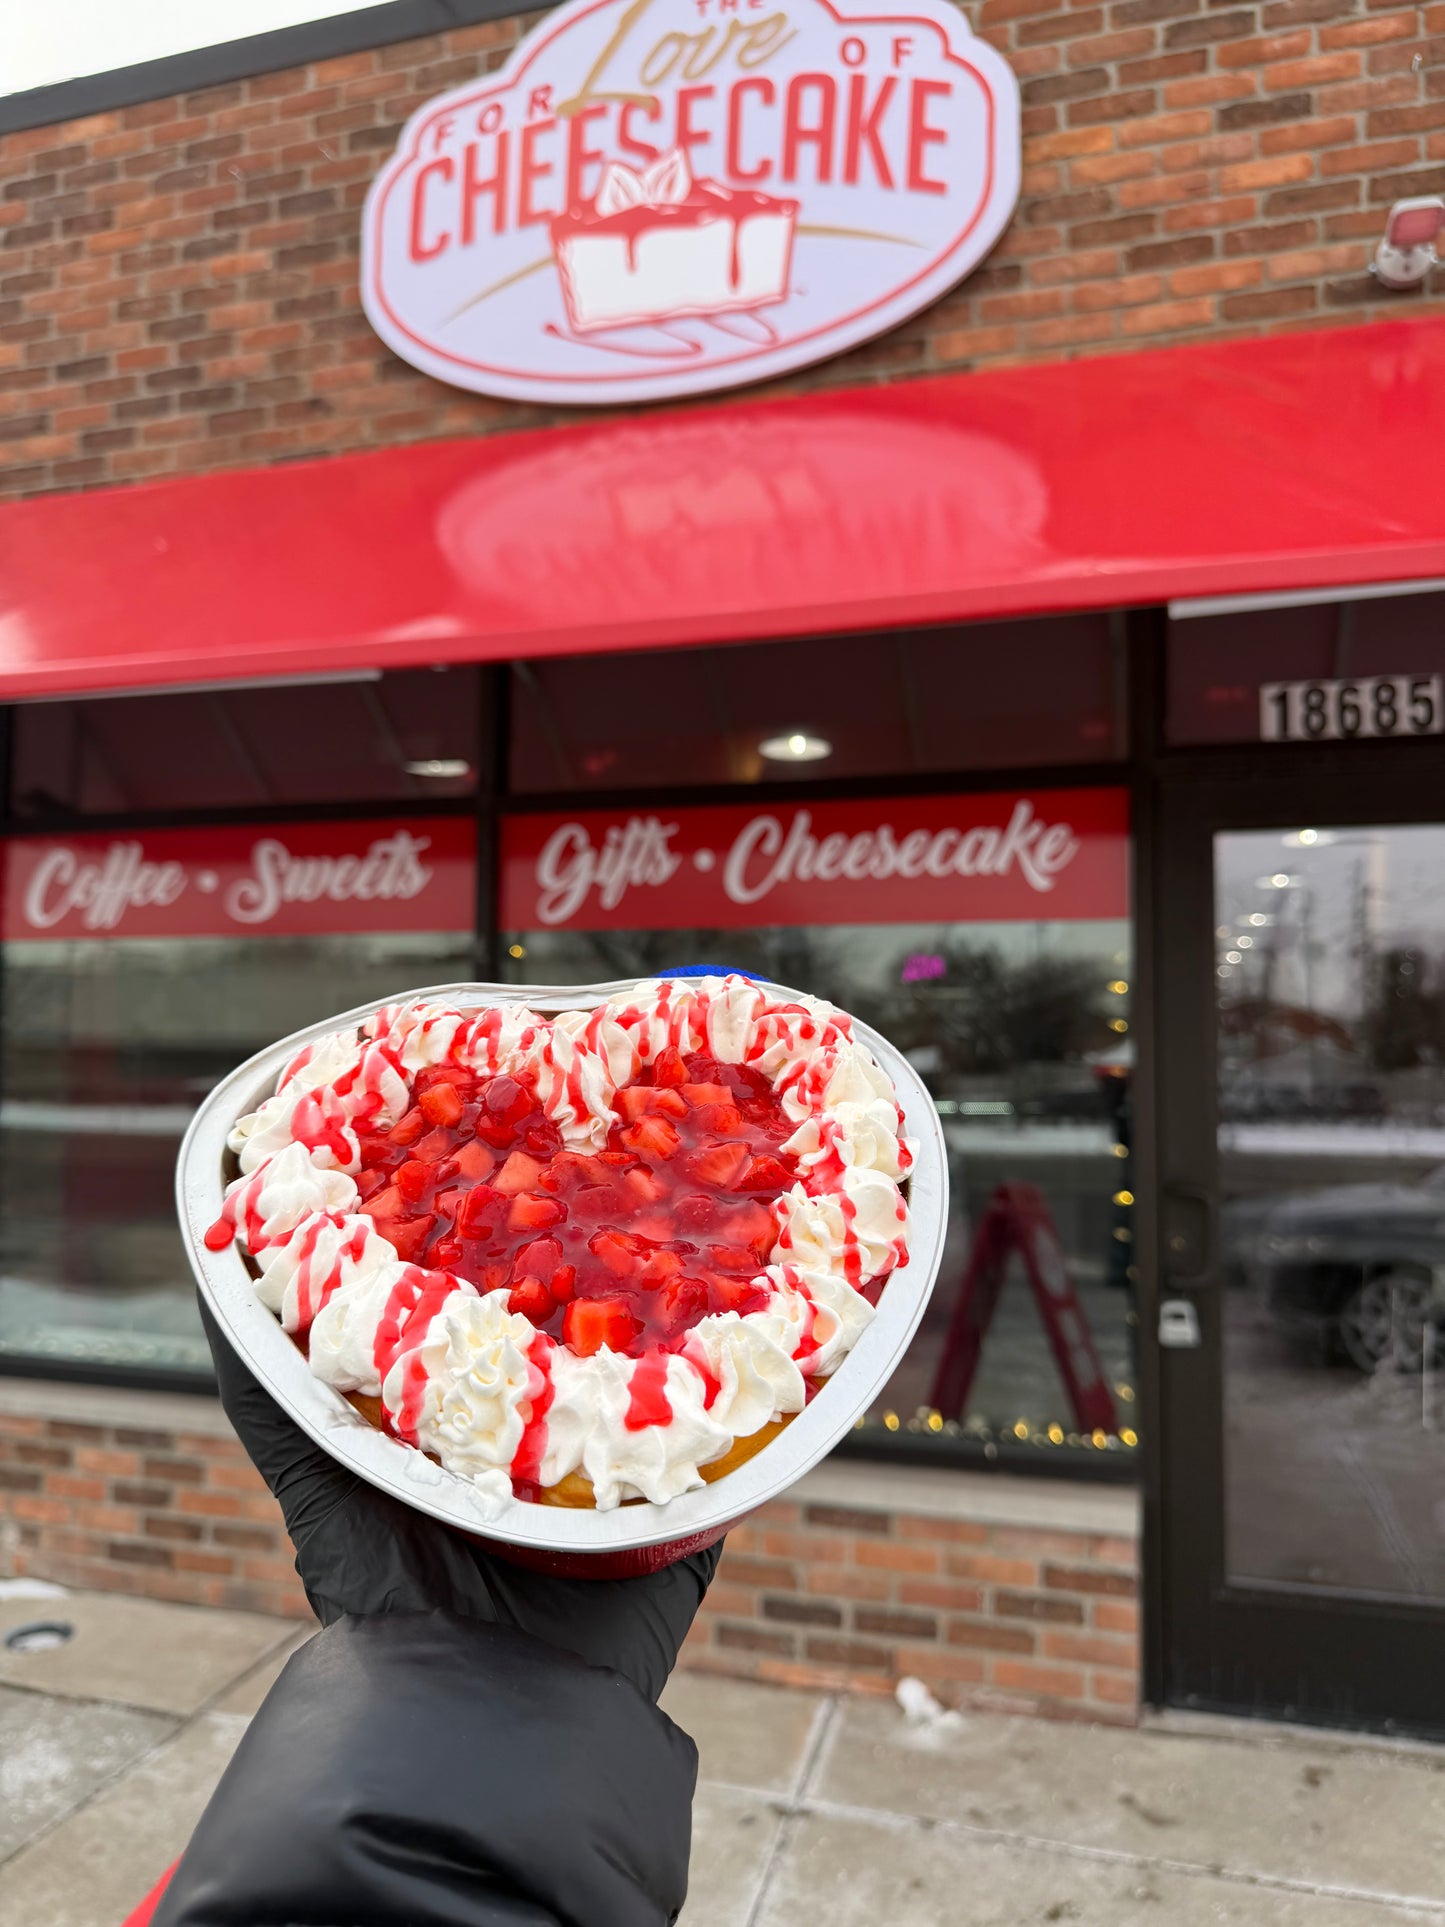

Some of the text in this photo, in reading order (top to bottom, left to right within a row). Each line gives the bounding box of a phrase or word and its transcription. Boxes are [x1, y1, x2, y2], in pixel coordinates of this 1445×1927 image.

[556, 0, 799, 118] Love
[839, 37, 915, 67] OF
[434, 85, 553, 151] FOR
[407, 72, 953, 264] CHEESECAKE
[1270, 680, 1434, 736] 18685
[24, 830, 432, 929] Coffee Sweets
[535, 800, 1080, 924] Gifts Cheesecake
